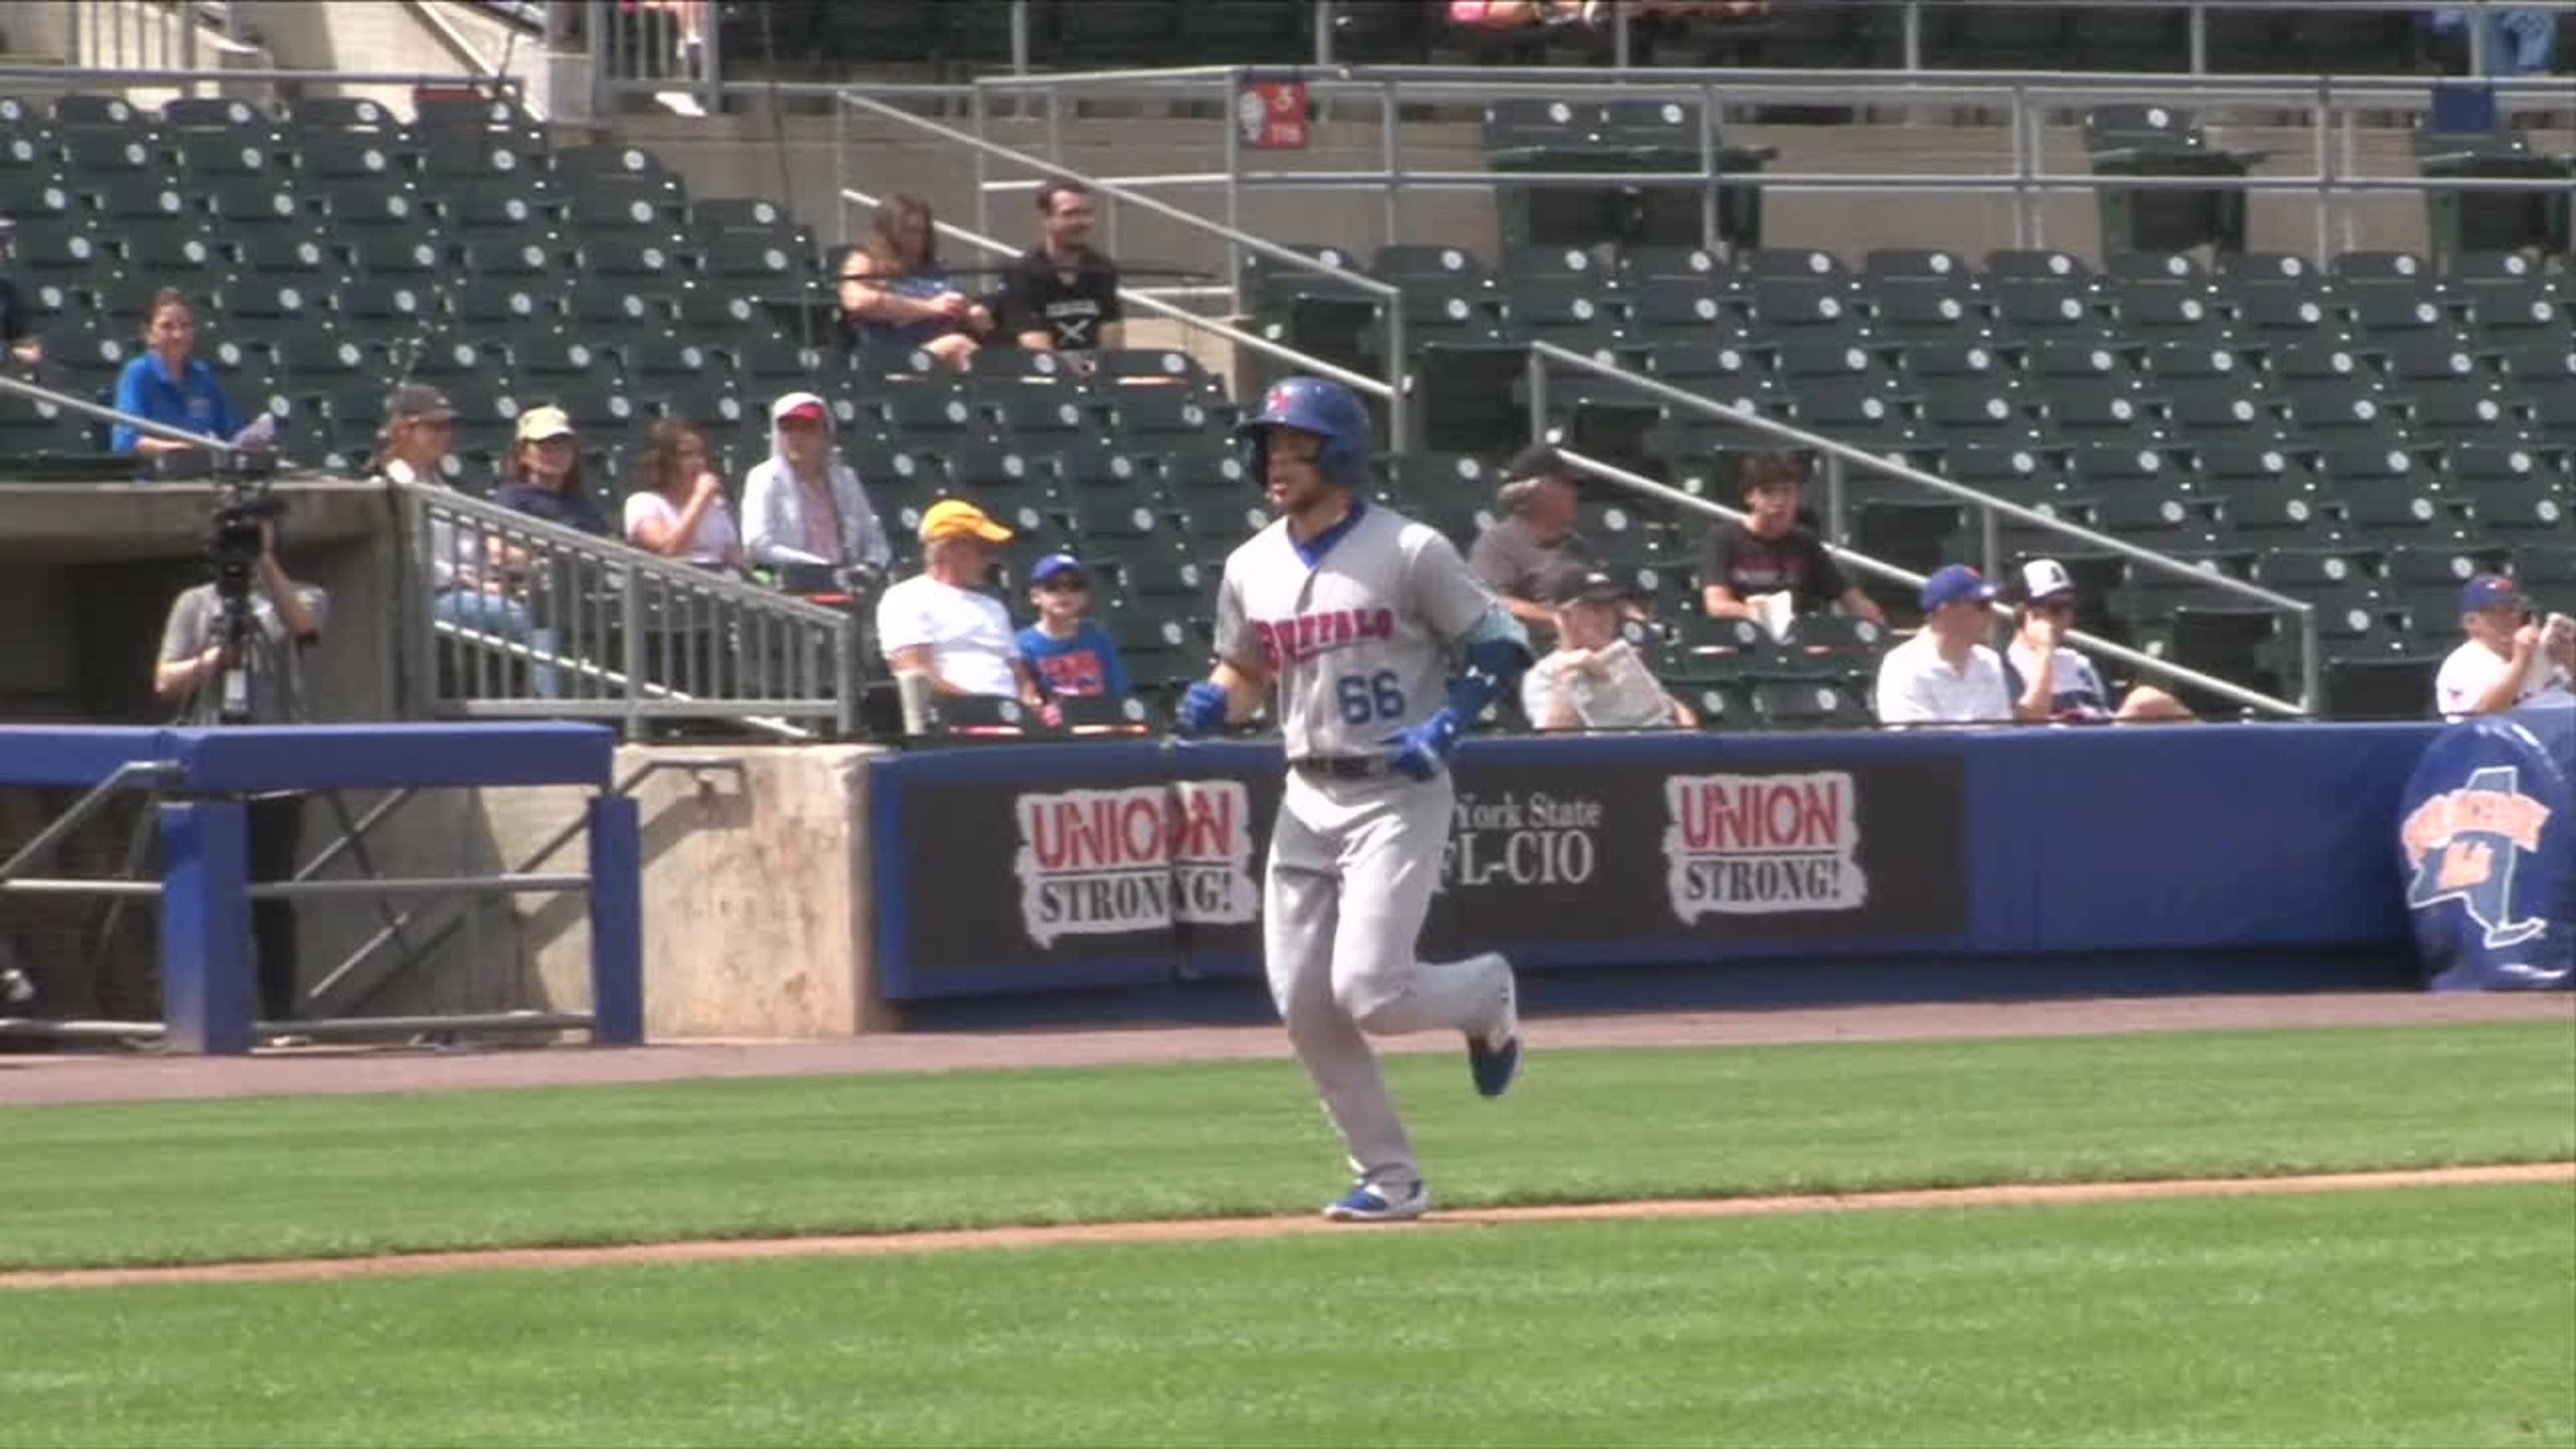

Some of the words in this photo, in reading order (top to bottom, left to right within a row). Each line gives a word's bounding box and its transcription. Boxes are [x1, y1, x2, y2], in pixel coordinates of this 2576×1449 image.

[1255, 606, 1394, 673] BUFFALO
[1337, 670, 1405, 724] 66
[1031, 788, 1233, 869] UNION
[1455, 792, 1523, 828] York
[1529, 791, 1603, 828] State
[1680, 781, 1839, 849] UNION
[1037, 869, 1234, 924] STRONG!
[1685, 857, 1841, 903] STRONG!
